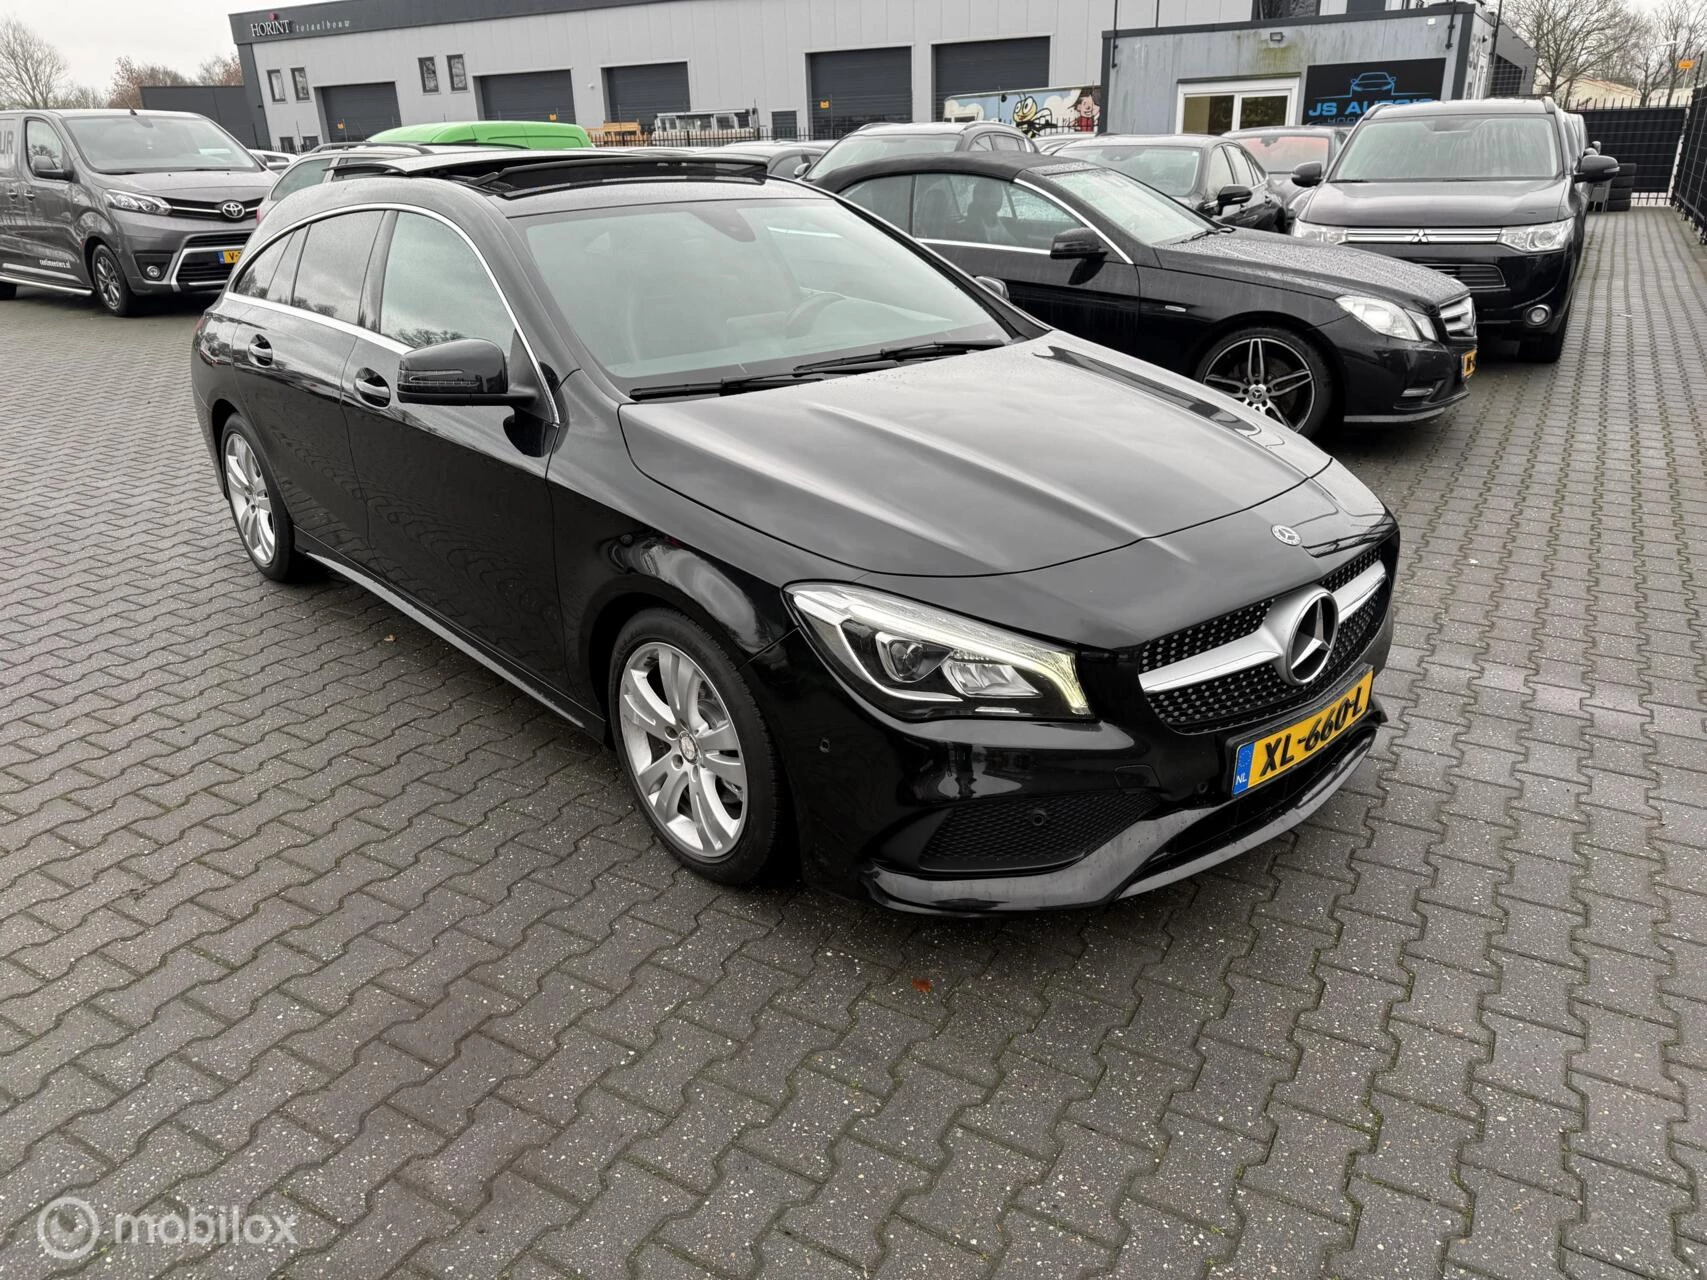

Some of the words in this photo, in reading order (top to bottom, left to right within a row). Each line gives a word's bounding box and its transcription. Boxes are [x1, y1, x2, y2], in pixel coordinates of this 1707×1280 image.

[250, 20, 290, 37] HORINT
[1308, 102, 1337, 116] JS
[1260, 686, 1362, 777] XL-660-L
[1235, 772, 1248, 786] NL
